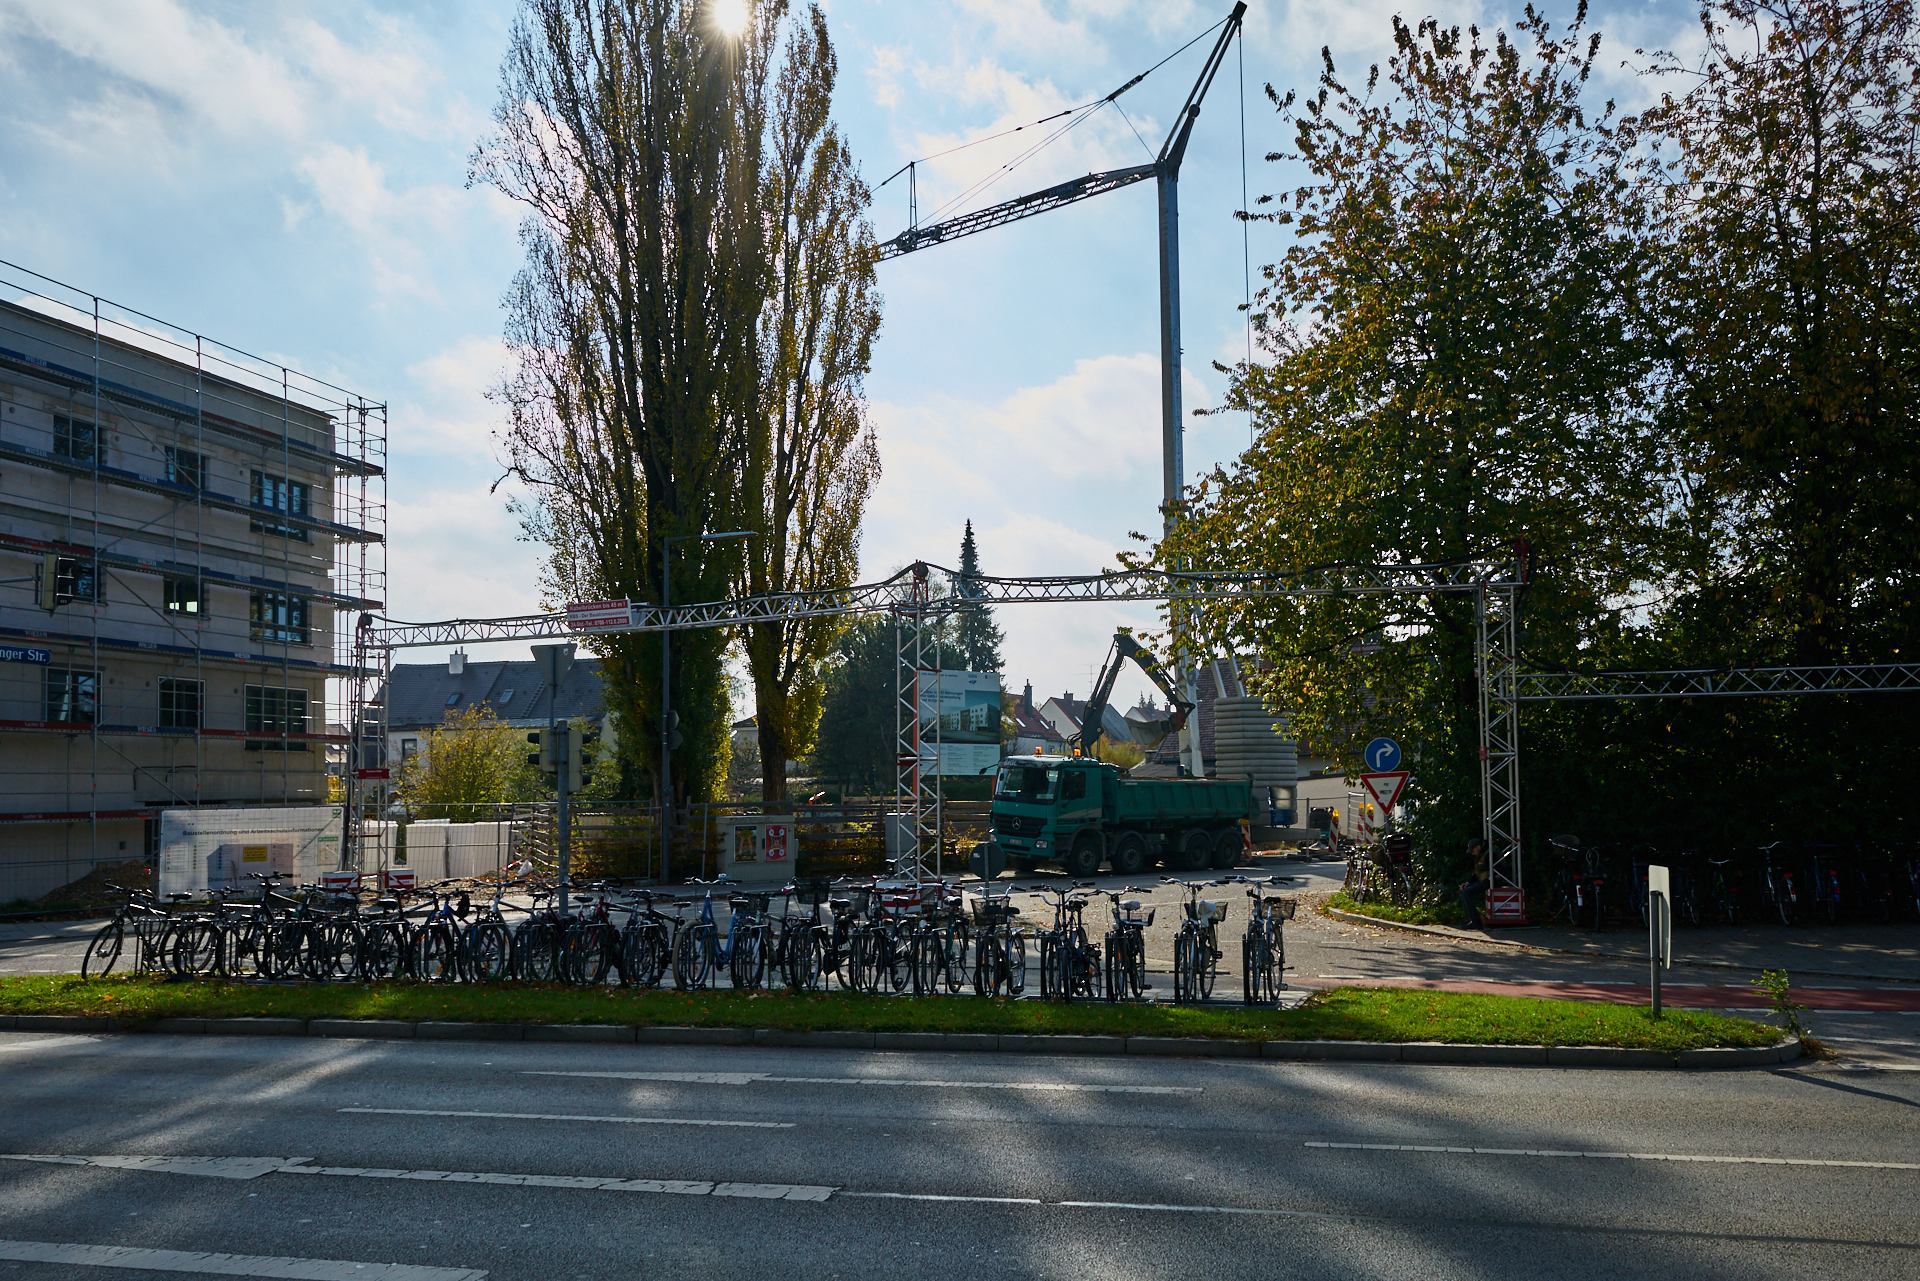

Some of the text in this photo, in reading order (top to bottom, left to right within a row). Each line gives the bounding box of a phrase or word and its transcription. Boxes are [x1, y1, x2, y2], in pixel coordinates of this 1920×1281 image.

[24, 355, 47, 367] WIESER
[25, 447, 47, 457] WIESER
[139, 474, 158, 484] WIESER
[138, 557, 157, 566] WIESER
[570, 603, 601, 611] Kabelbrücken
[25, 629, 47, 637] WIESER
[28, 649, 46, 662] Str.
[182, 829, 238, 837] Baustellenordnung
